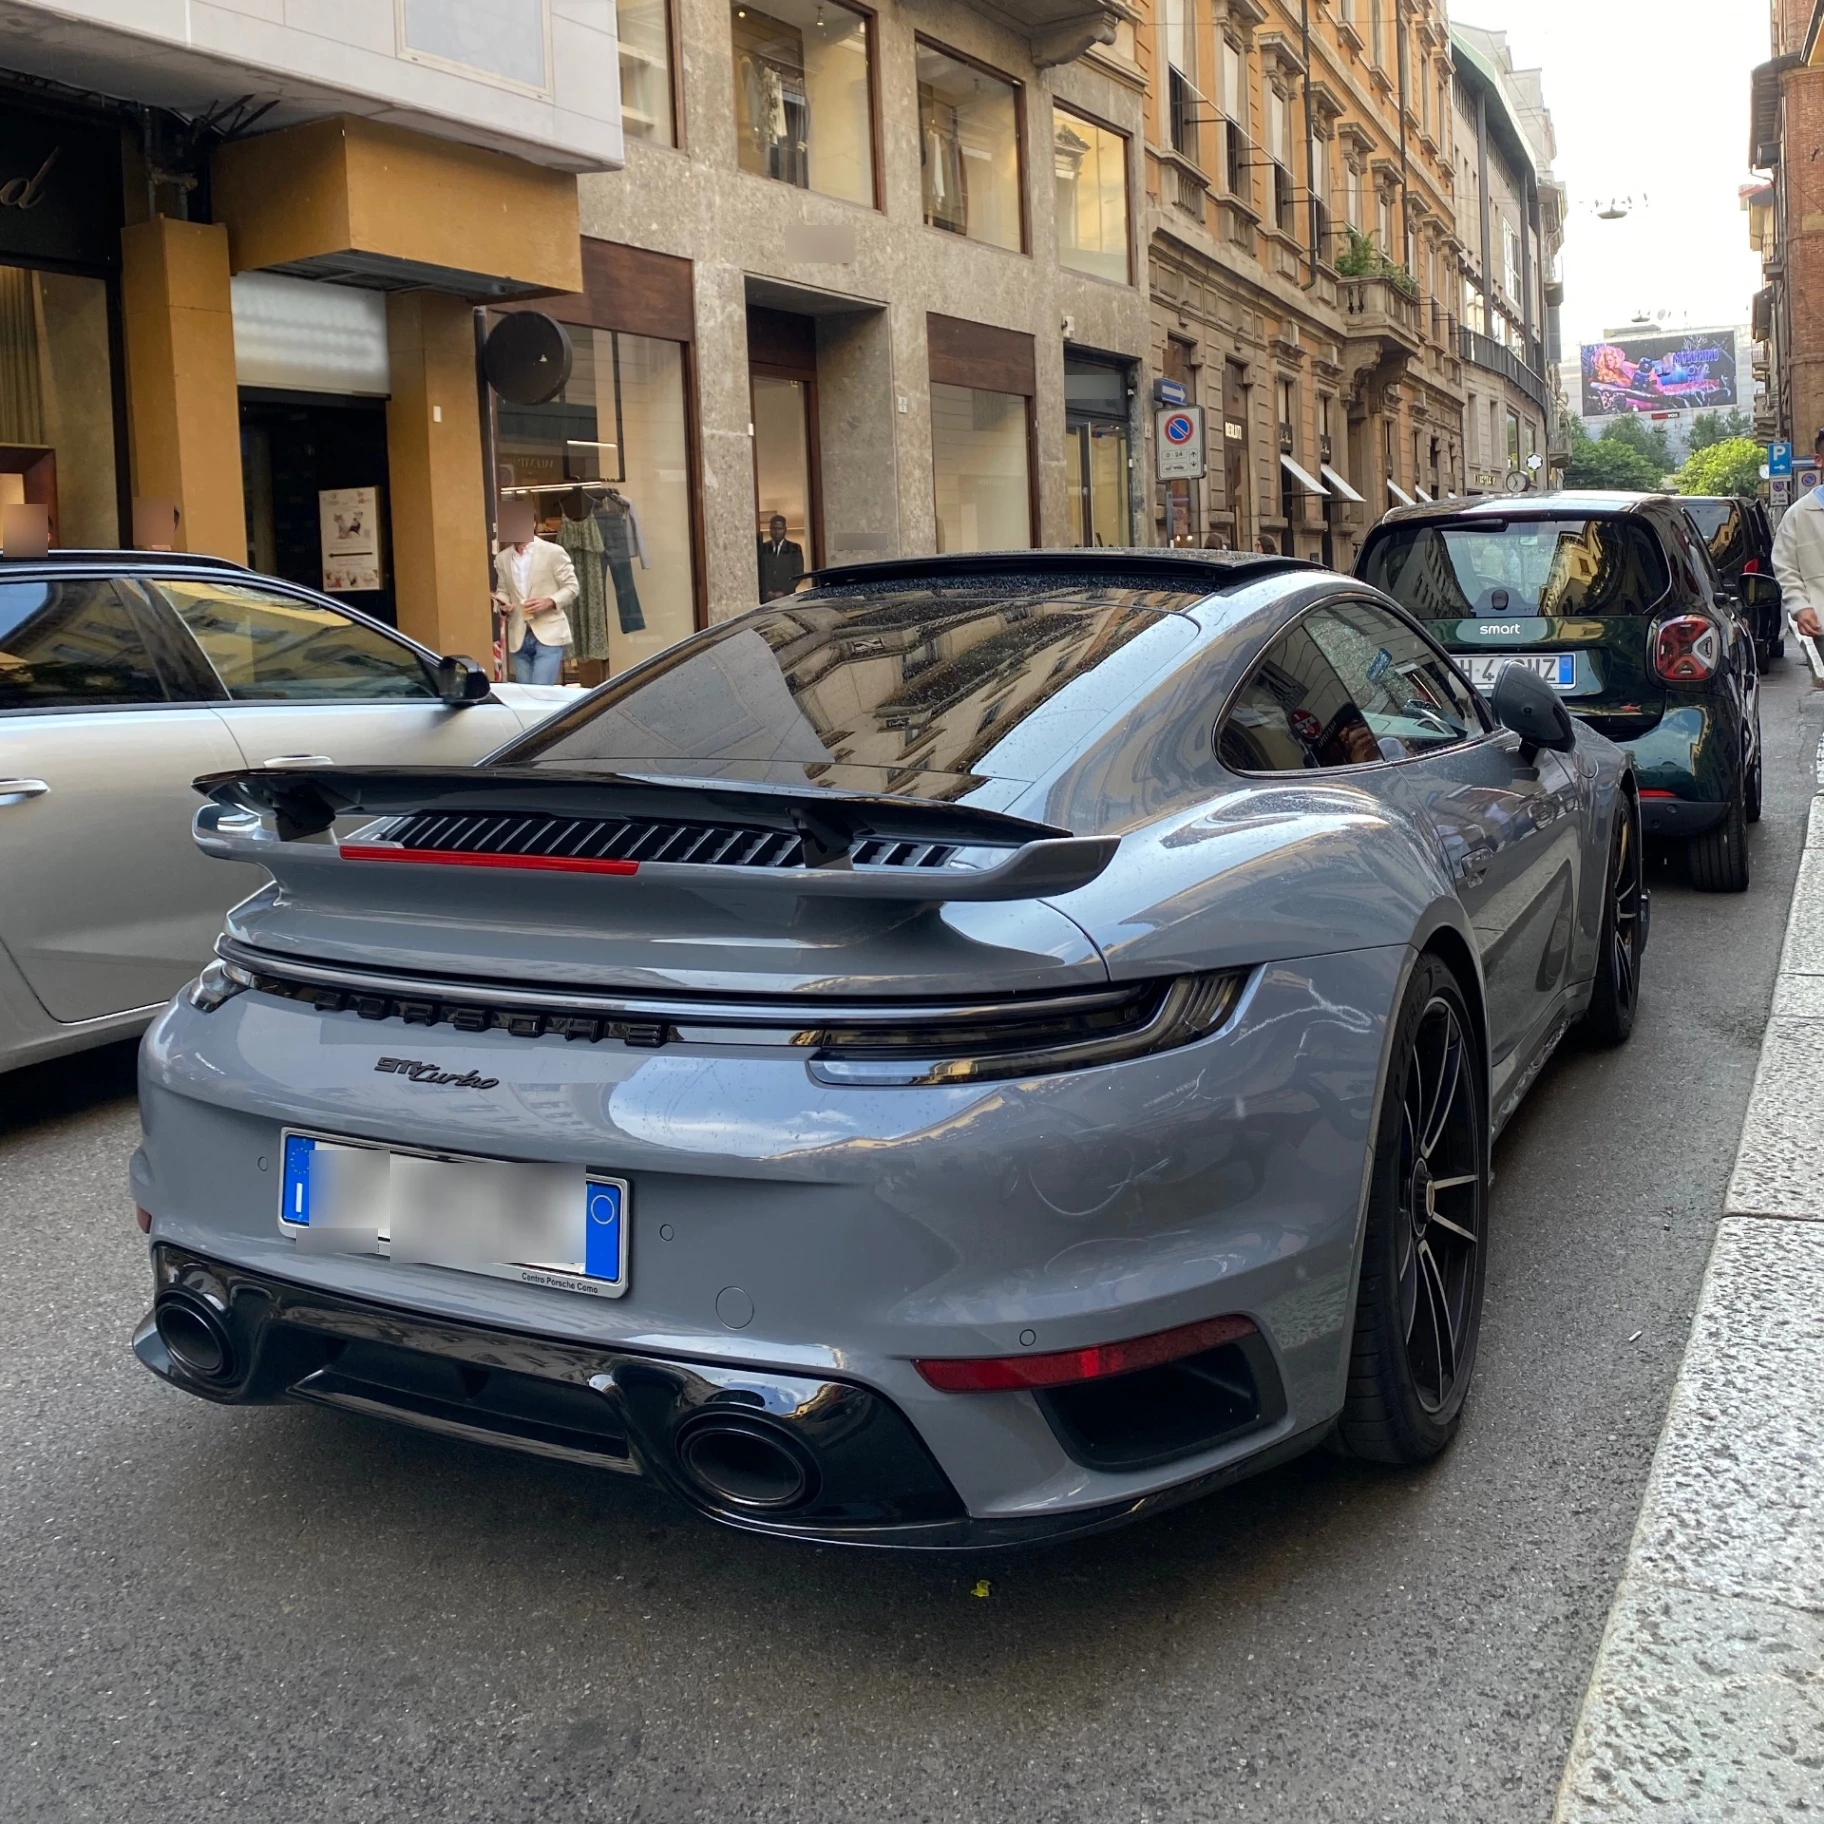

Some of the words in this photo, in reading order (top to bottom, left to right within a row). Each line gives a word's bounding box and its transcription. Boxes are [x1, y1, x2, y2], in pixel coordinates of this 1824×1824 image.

[1773, 445, 1786, 461] P
[1480, 623, 1520, 634] smart
[314, 990, 664, 1048] PORSCHE
[521, 1272, 545, 1283] Centro
[547, 1277, 576, 1290] Porsche
[577, 1283, 598, 1293] Como
